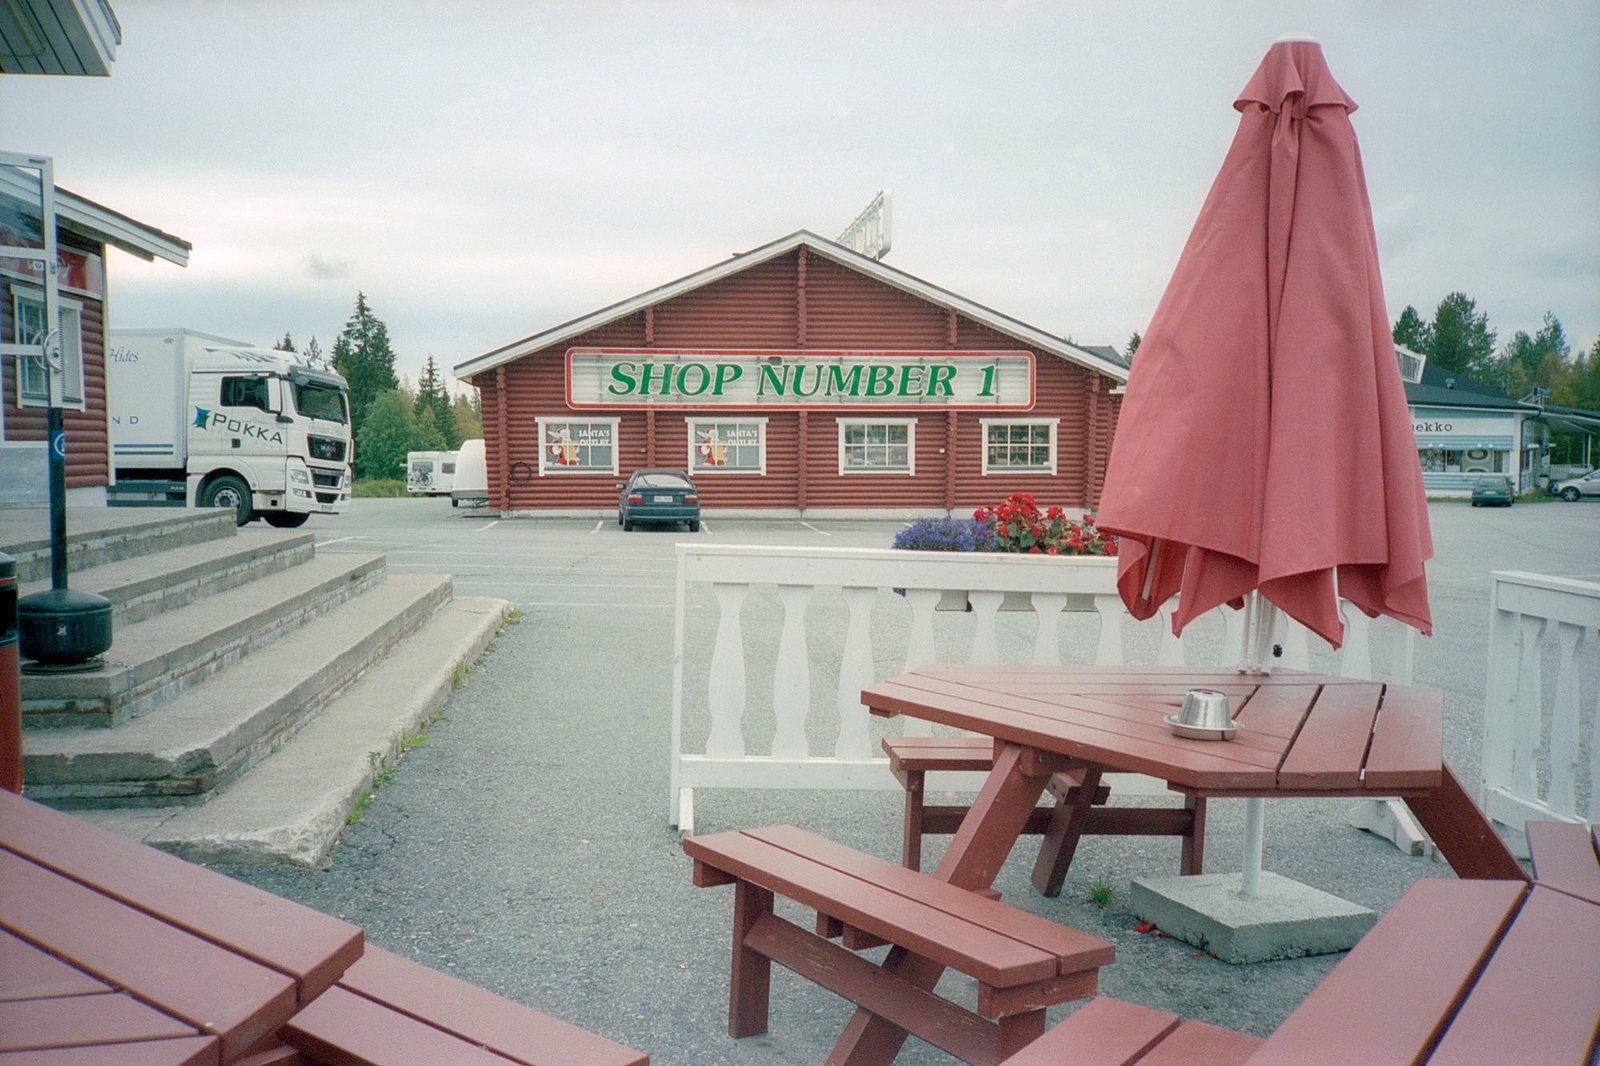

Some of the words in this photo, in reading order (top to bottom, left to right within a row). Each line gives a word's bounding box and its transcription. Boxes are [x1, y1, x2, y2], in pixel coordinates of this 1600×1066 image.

[607, 362, 744, 396] SHOP
[756, 364, 957, 397] NUMBER
[977, 364, 996, 396] 1
[212, 413, 283, 444] POKKA
[579, 429, 610, 437] SANTA'S
[727, 429, 758, 437] SANTA'S
